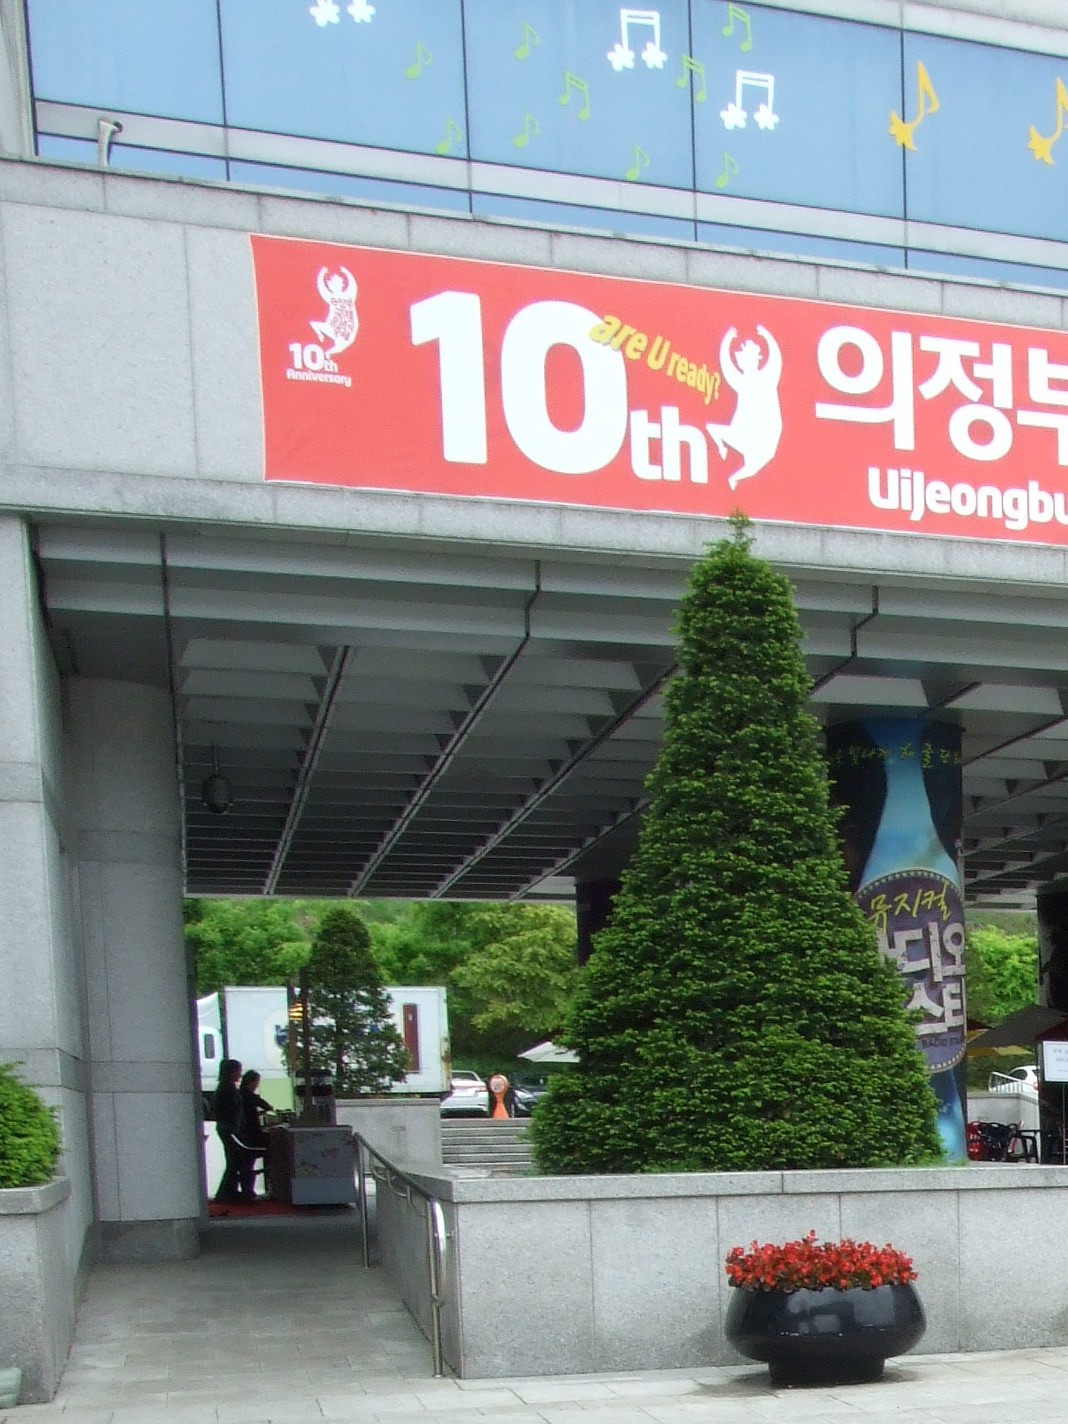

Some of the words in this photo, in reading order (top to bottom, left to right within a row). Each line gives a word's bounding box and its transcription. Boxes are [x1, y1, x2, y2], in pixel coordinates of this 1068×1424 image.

[286, 367, 352, 388] Anniversary
[289, 342, 338, 372] 10th
[588, 314, 648, 361] are
[646, 335, 671, 371] U
[666, 352, 721, 405] ready?
[410, 290, 709, 483] 10th
[869, 880, 951, 936] 뮤지컬
